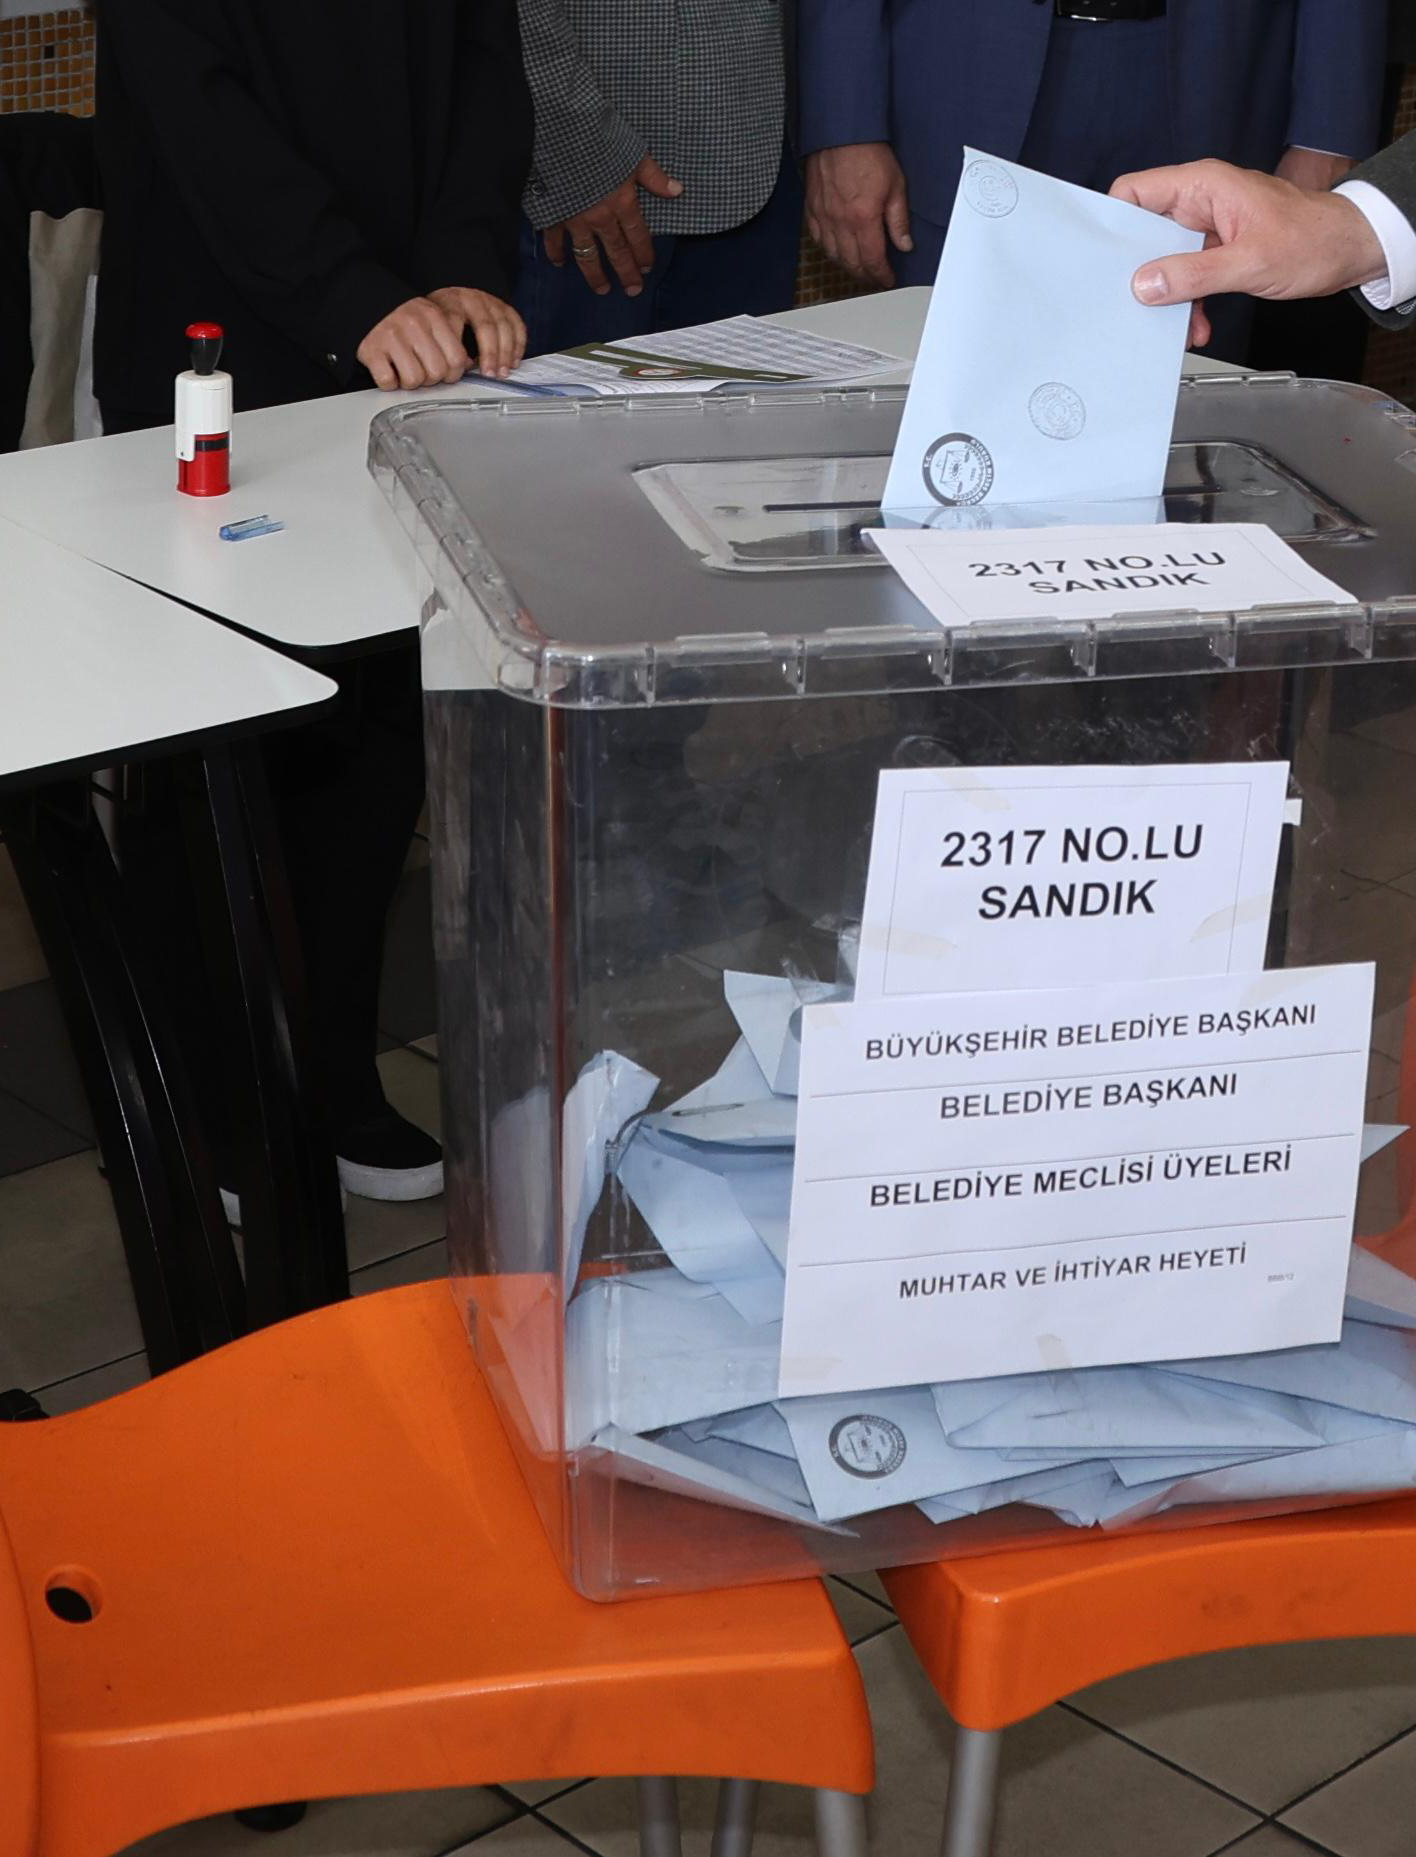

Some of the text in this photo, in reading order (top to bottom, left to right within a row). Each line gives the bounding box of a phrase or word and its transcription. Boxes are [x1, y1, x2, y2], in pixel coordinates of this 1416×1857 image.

[969, 551, 1226, 576] 2317 NO.LU
[1029, 572, 1208, 593] SANDIK
[941, 825, 1202, 867] 2317 NO.LU
[979, 880, 1156, 919] SANDIK
[867, 1005, 1315, 1059] BÜYÜKŞEHİR BELEDİYE BAŞKANI
[941, 1074, 1236, 1118] BELEDİYE BAŞKANI
[871, 1150, 1290, 1206] BELEDİYE MECLİSİ ÜYELERİ
[900, 1246, 1245, 1298] MUHTAR VE İHTİYAR HEYETİ
